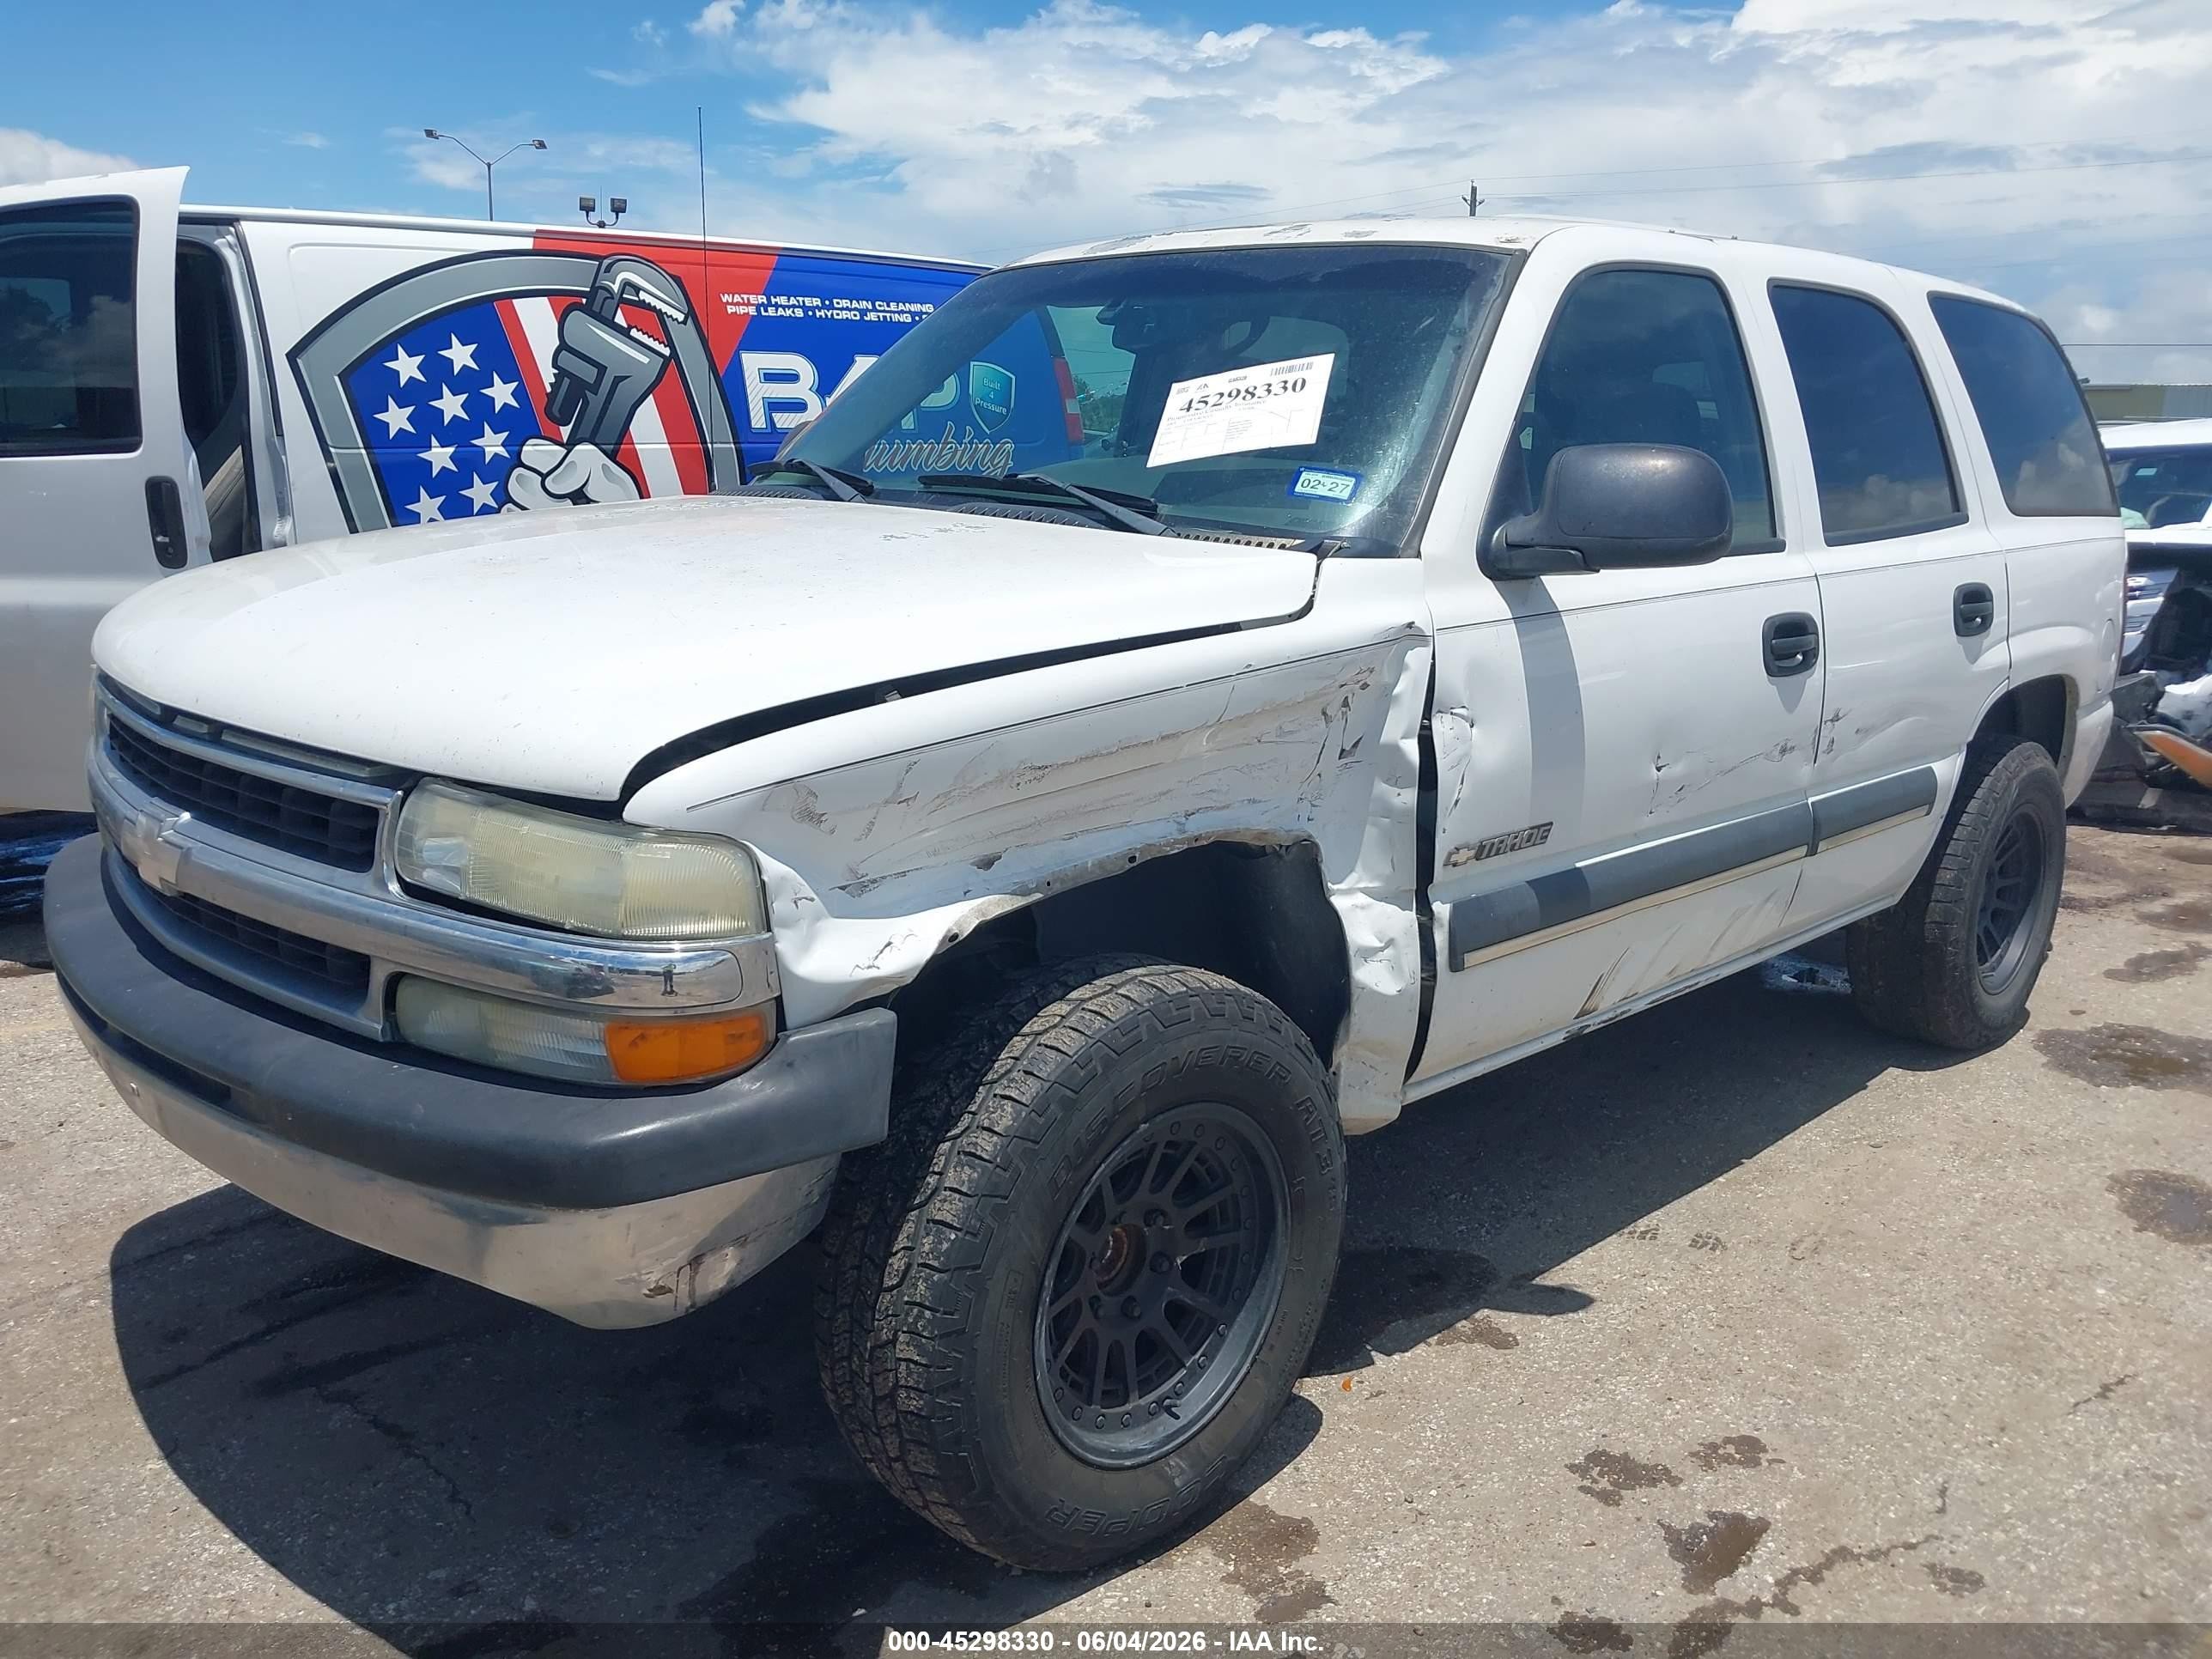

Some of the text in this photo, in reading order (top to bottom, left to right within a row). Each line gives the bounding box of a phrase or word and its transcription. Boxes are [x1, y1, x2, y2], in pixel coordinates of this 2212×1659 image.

[720, 293, 934, 313] WATER HEATER DRAIN CLEANING
[726, 305, 757, 316] PIPE
[760, 307, 804, 318] LEAKS
[816, 309, 860, 321] HYDRO
[864, 312, 911, 324] JETTING
[983, 377, 1001, 391] Built
[988, 391, 994, 399] 4
[1178, 376, 1307, 414] 45298330
[975, 397, 1007, 416] Pressure
[1301, 477, 1322, 490] 02
[1327, 481, 1351, 494] 27
[1480, 823, 1553, 860] TAHOE
